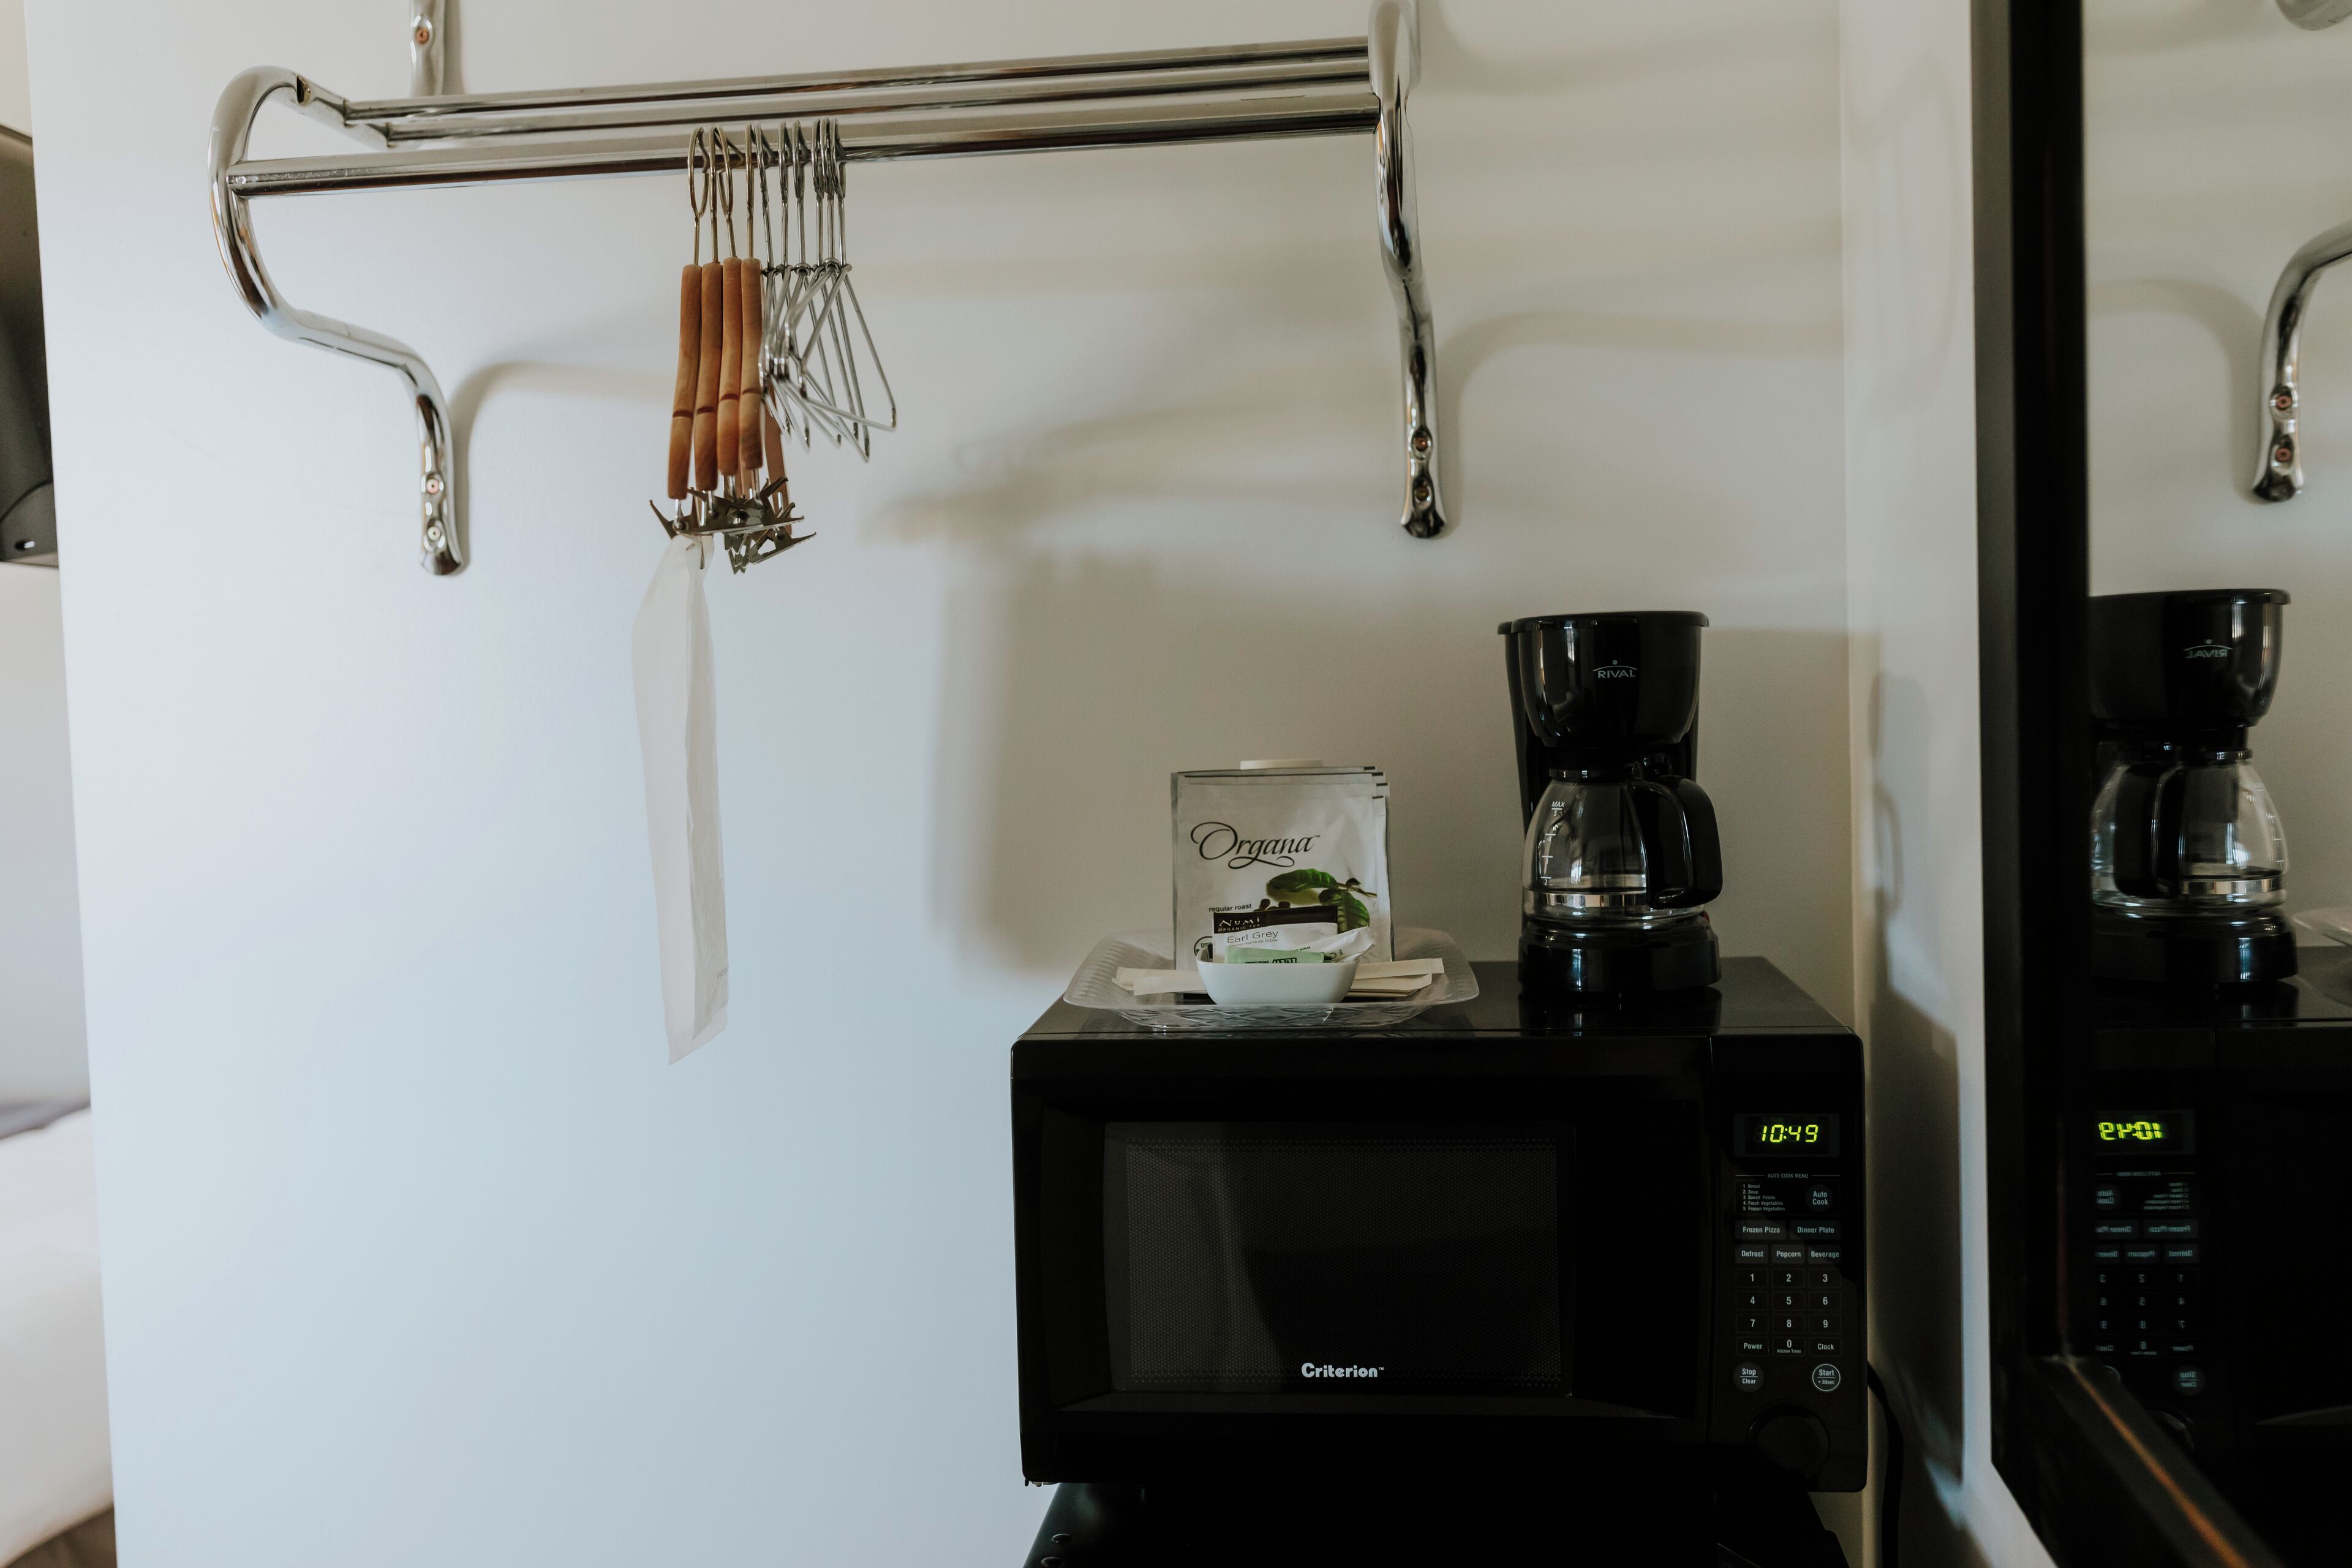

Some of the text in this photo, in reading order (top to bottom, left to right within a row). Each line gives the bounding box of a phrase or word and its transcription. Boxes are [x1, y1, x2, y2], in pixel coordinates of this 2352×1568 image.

[1597, 669, 1636, 679] RIVAL
[1227, 930, 1279, 944] Earl Grey
[1762, 1125, 1819, 1142] 10:49
[1750, 1273, 1754, 1282] 1
[1786, 1273, 1792, 1282] 2
[1822, 1273, 1828, 1283] 3
[1750, 1296, 1755, 1305] 4
[1786, 1296, 1792, 1305] 5
[1822, 1297, 1828, 1305] 6
[1750, 1319, 1755, 1327] 7
[1787, 1319, 1792, 1328] 8
[1823, 1319, 1828, 1328] 9
[1787, 1339, 1792, 1348] 0
